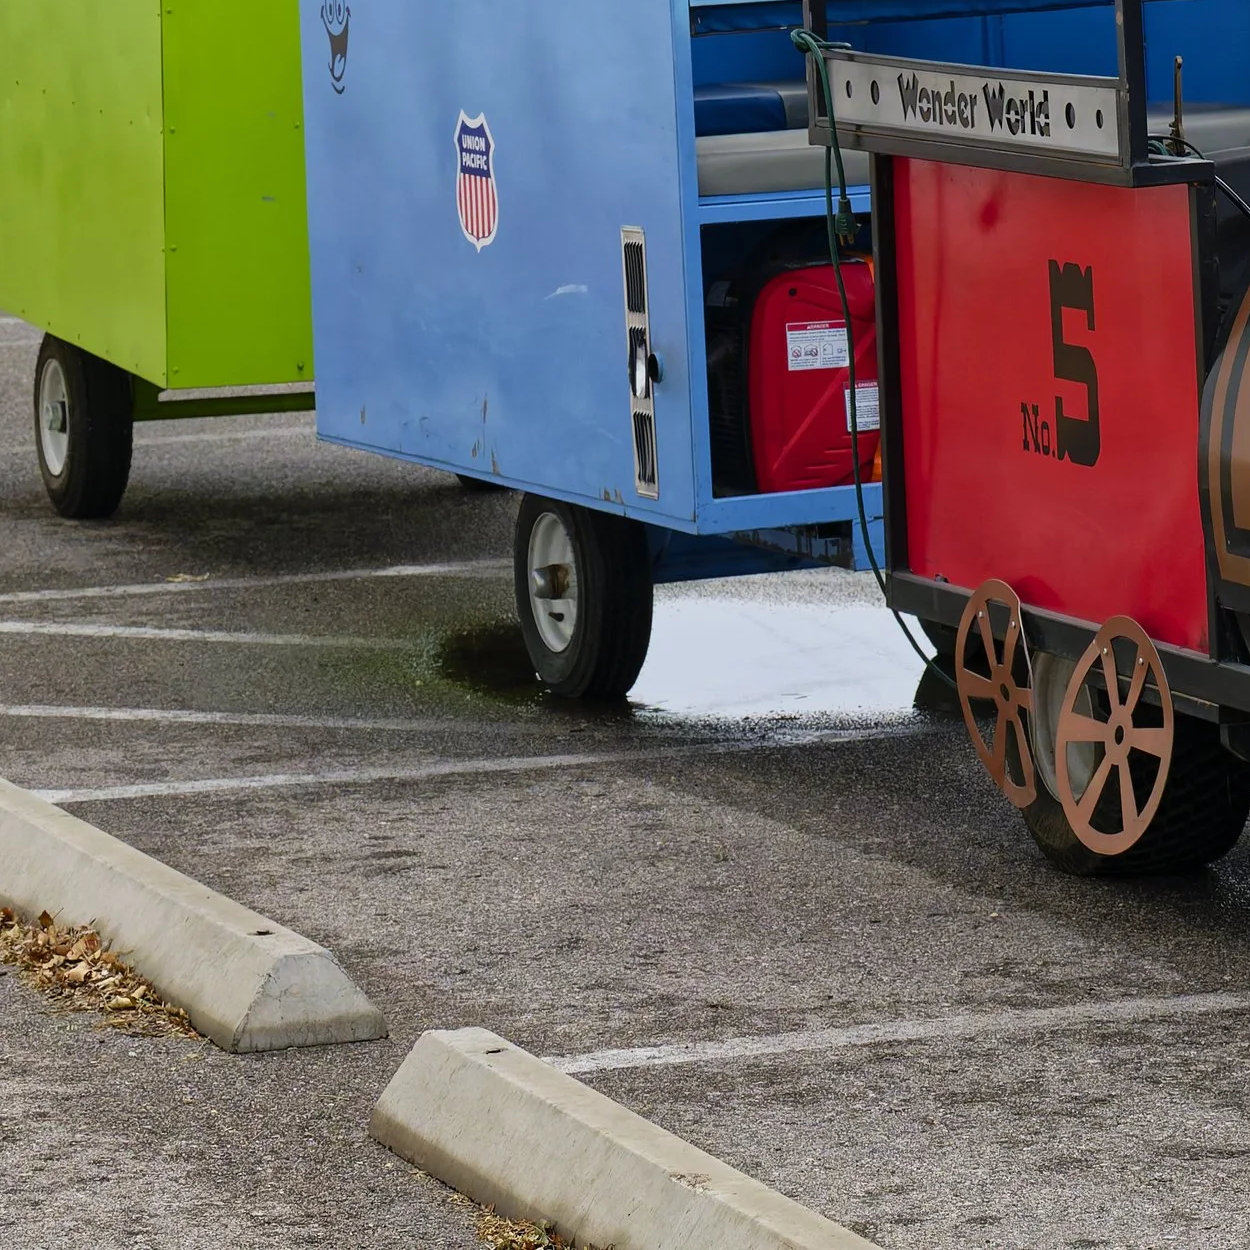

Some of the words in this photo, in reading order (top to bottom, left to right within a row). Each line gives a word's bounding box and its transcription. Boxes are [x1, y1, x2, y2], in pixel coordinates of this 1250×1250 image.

[897, 72, 978, 129] Wonder
[982, 81, 1051, 137] World
[461, 134, 486, 151] UNION
[461, 152, 488, 170] PACIFIC
[1020, 401, 1056, 456] No.
[1047, 258, 1101, 468] 5
